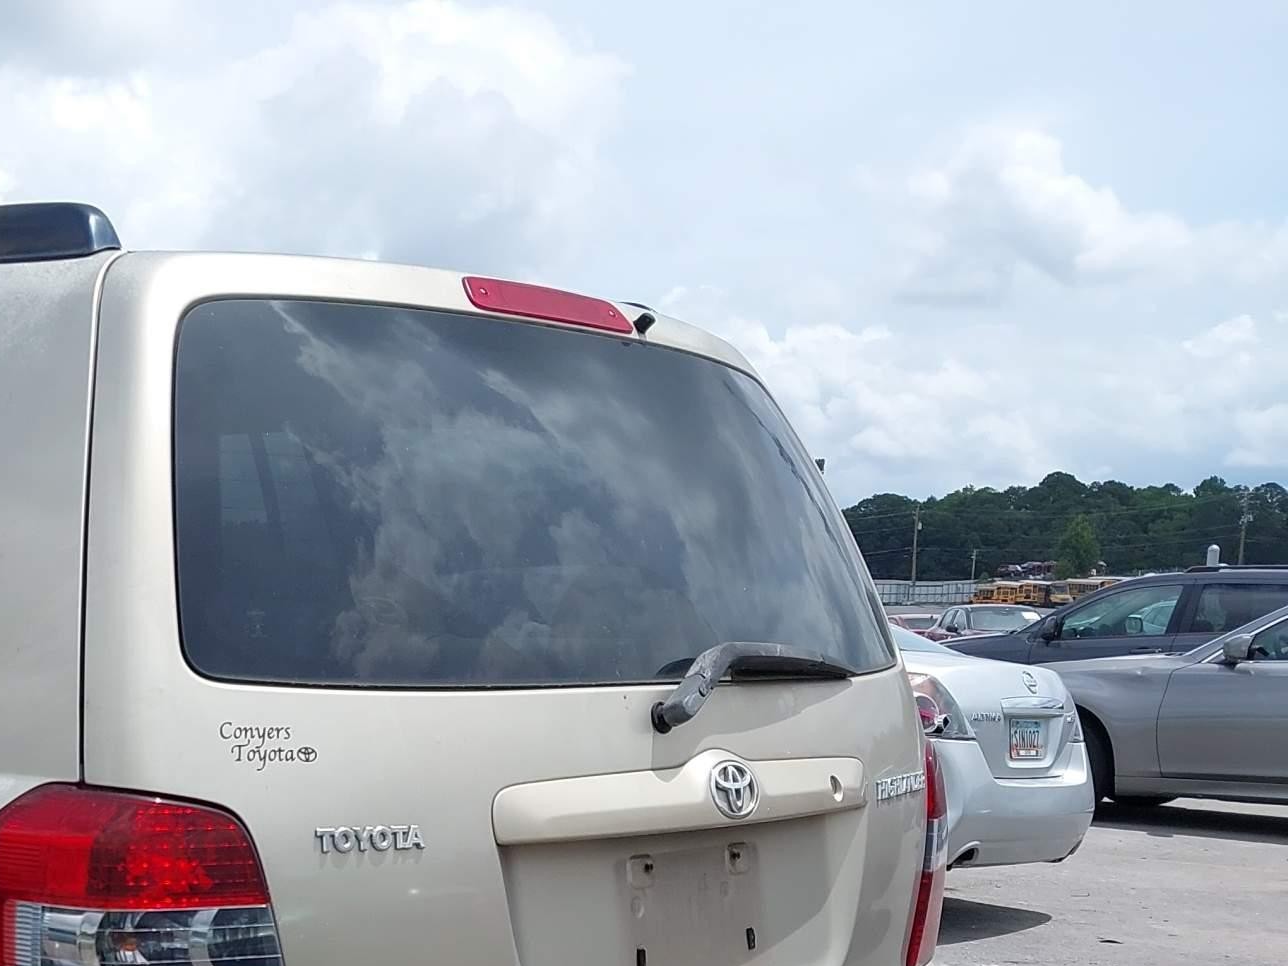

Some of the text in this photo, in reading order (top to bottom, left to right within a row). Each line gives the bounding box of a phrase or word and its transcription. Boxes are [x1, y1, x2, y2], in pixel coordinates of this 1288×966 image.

[218, 721, 292, 748] Conyers
[231, 740, 297, 771] Toyota
[315, 824, 425, 854] TOYOTA
